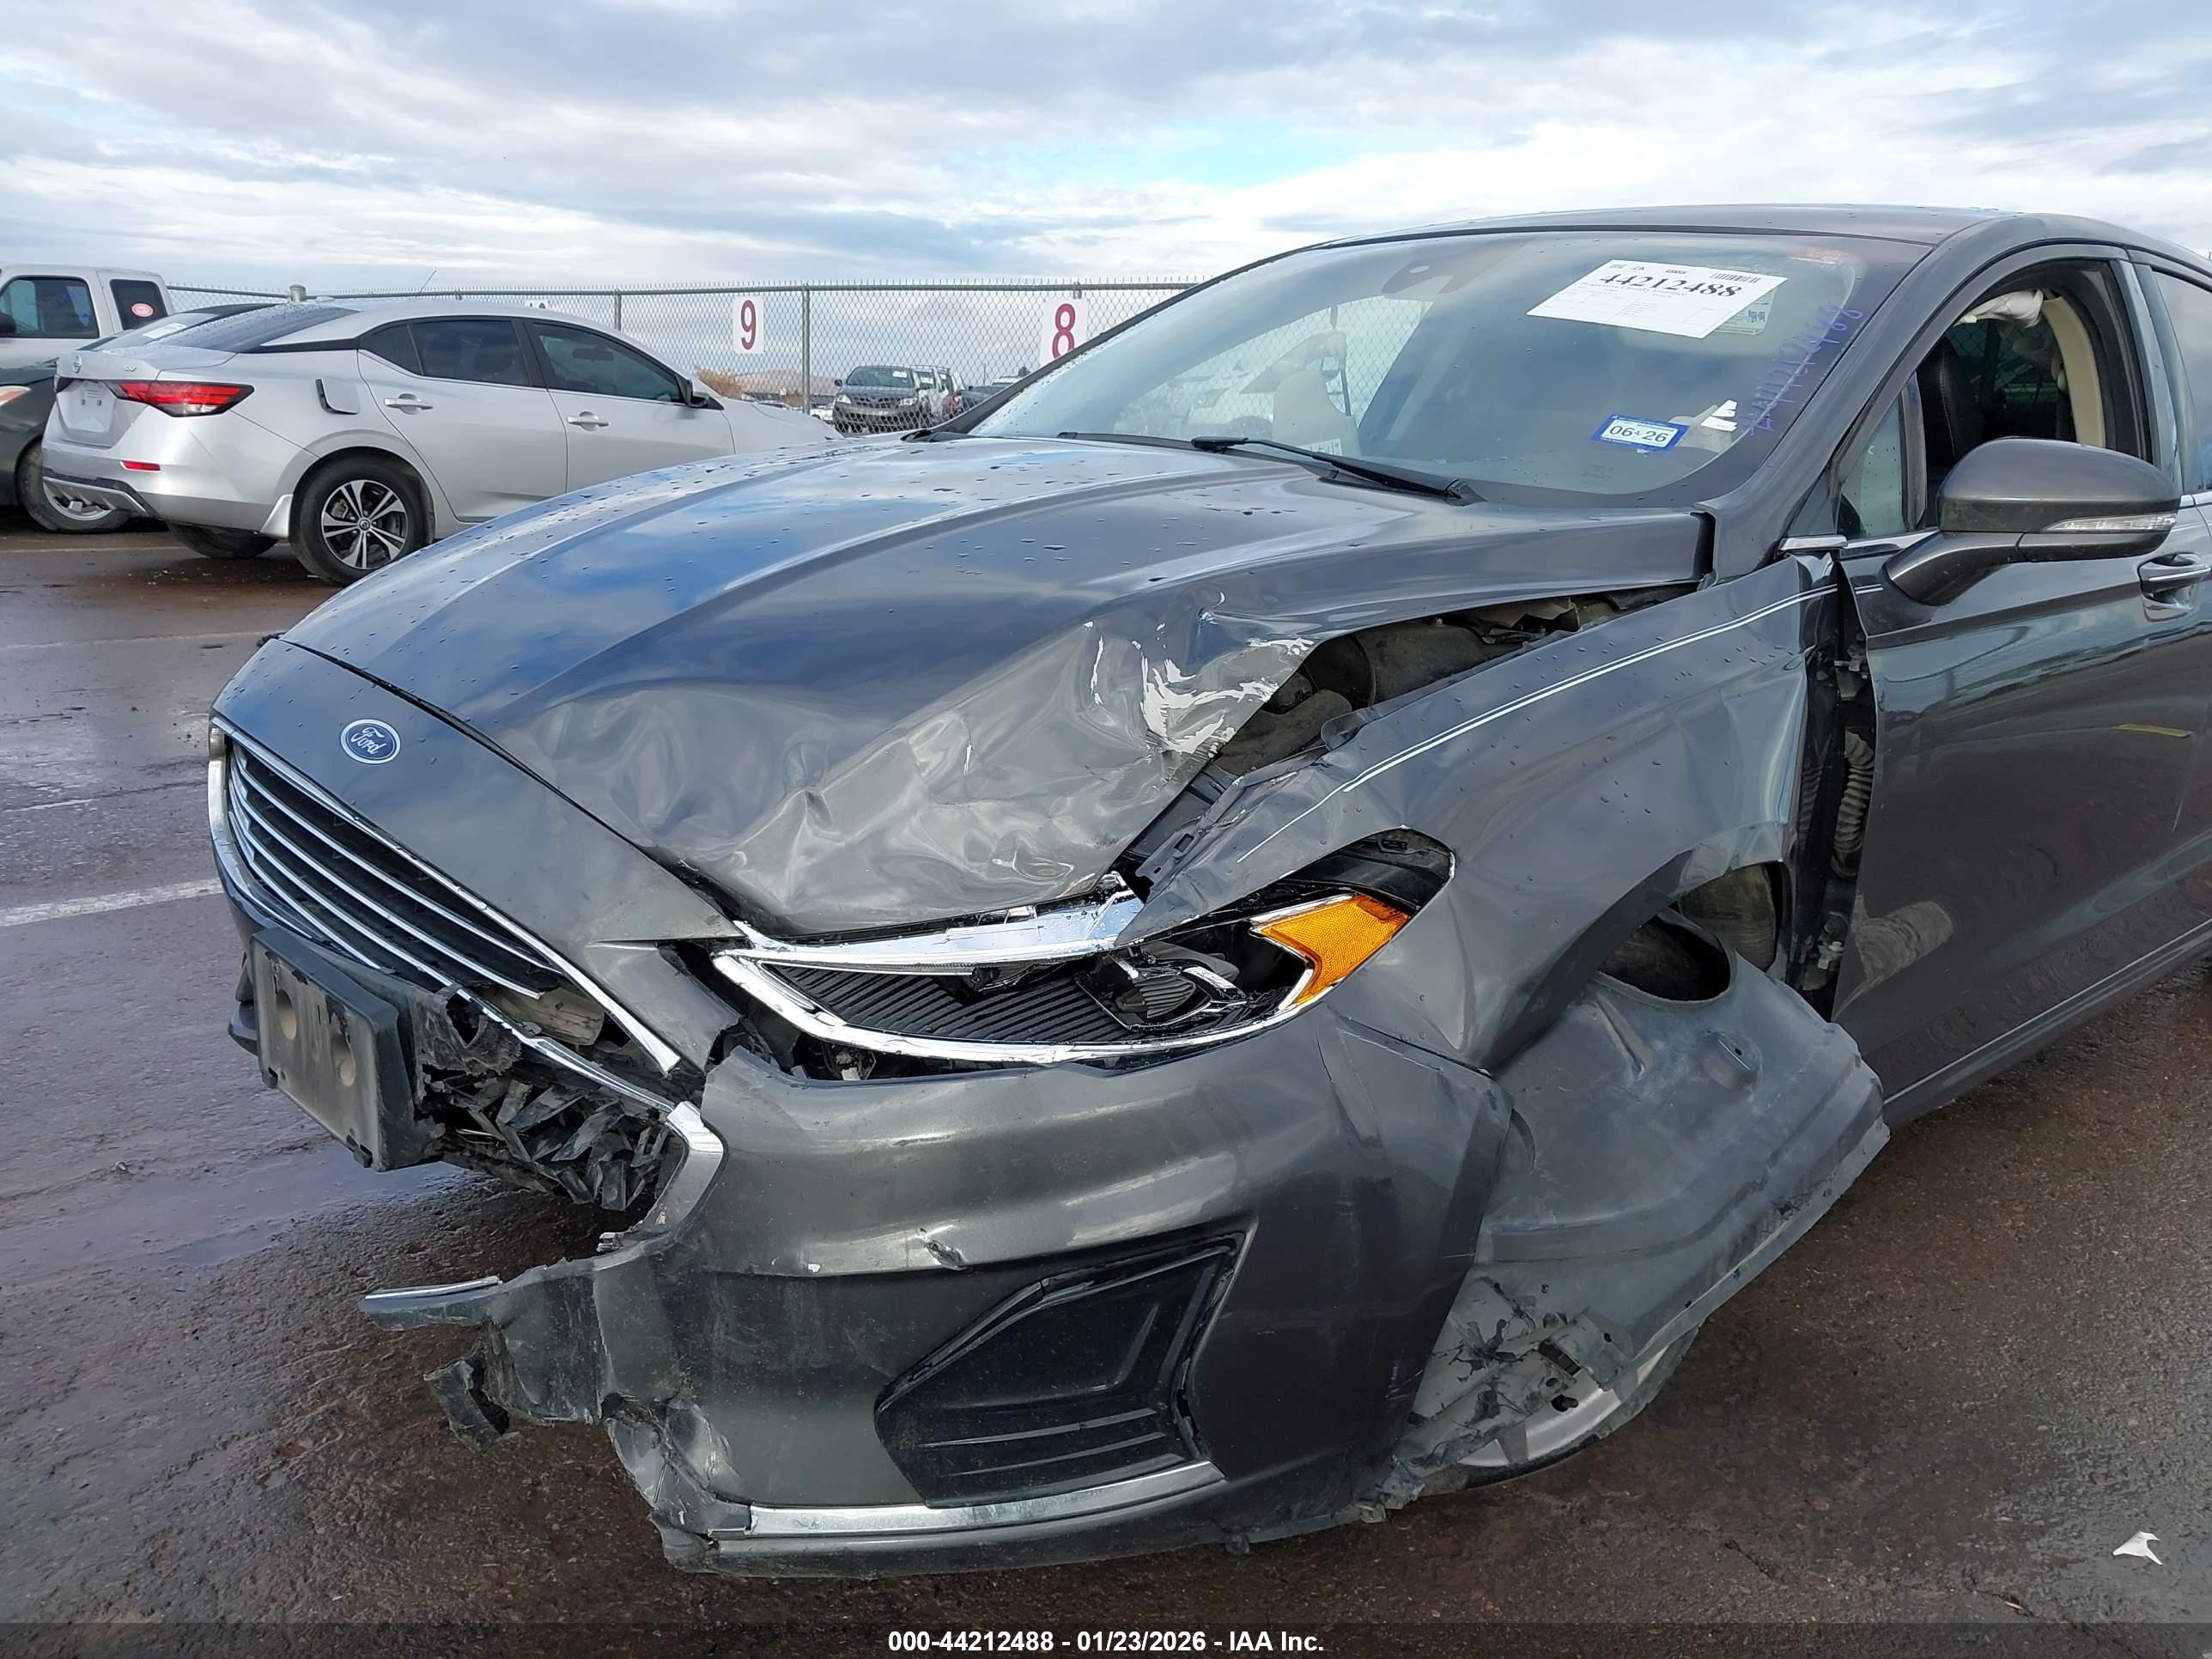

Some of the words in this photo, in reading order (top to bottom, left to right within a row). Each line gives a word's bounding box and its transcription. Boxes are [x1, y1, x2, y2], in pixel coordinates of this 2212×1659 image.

[1601, 273, 1742, 297] 44212488
[741, 300, 756, 350] 9
[1052, 303, 1076, 359] 8
[1609, 425, 1635, 437] 06
[1642, 430, 1669, 442] 26
[351, 727, 387, 754] Ford
